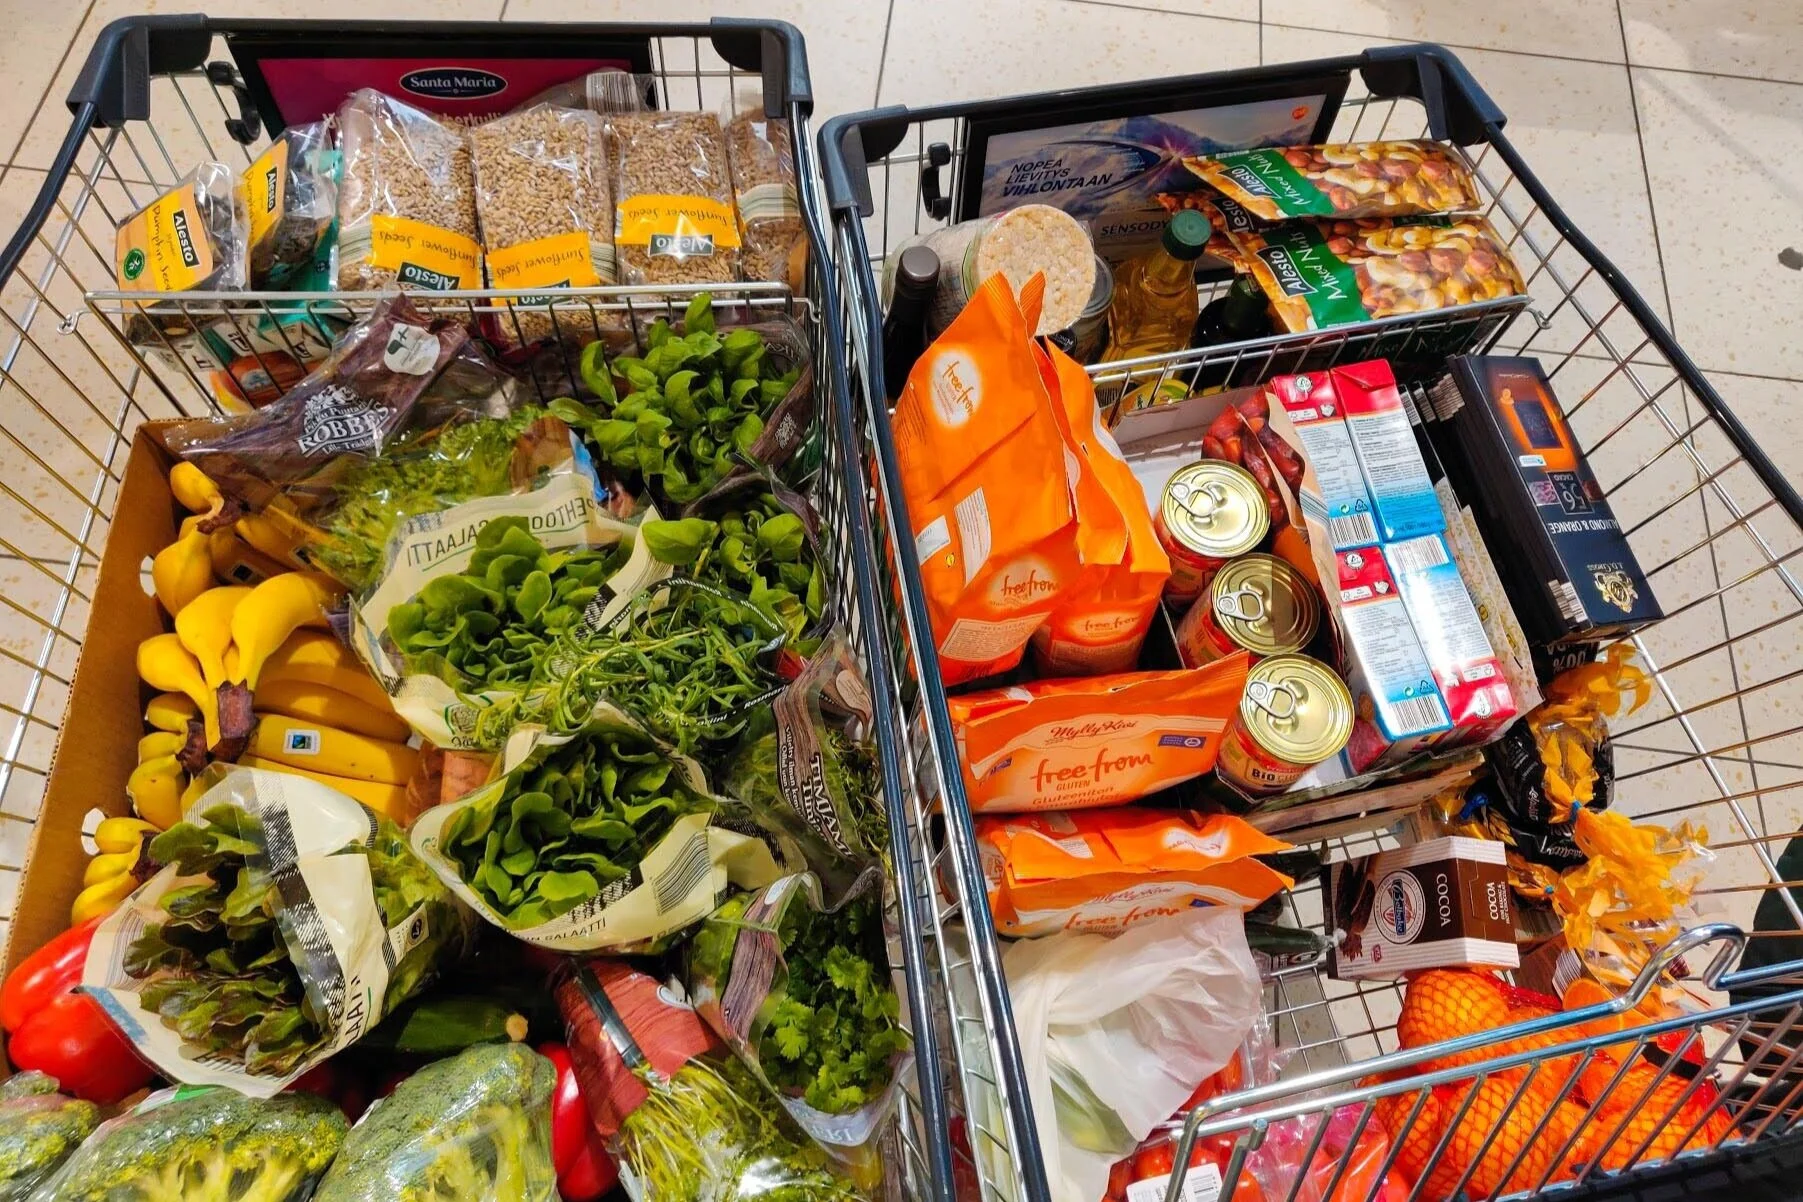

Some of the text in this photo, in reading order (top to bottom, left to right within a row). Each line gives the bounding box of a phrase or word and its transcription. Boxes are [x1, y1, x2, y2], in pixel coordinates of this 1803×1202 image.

[410, 76, 497, 89] Santa Maria
[1006, 168, 1071, 184] LIEVITYS
[1011, 158, 1063, 174] NOPEA
[266, 170, 277, 211] Alesto
[1003, 173, 1113, 197] VIHLONTAAN
[1231, 167, 1273, 196] Alesto
[1267, 174, 1312, 206] Mixed
[627, 206, 728, 226] Sunflower Seeds
[1102, 220, 1169, 235] SENSODY
[1222, 201, 1249, 233] lesto
[173, 214, 194, 263] Alesto
[378, 231, 478, 269] Sunflower Seeds
[656, 236, 712, 251] Alesto
[496, 249, 584, 278] Sunflower Seeds
[1269, 250, 1308, 291] Alesto
[404, 265, 456, 290] Alesto
[1304, 264, 1348, 300] Mixed
[297, 401, 390, 455] ROBBES
[1553, 474, 1574, 482] CACAO
[1549, 520, 1582, 534] ORANGE
[1001, 575, 1026, 598] free
[1083, 619, 1109, 632] free
[1031, 758, 1086, 792] free
[1086, 747, 1154, 781] from
[1056, 778, 1091, 792] GLUTEN
[1392, 884, 1405, 932] Belbake
[1436, 872, 1451, 928] COCOA
[1486, 881, 1499, 921] COCOA
[1065, 905, 1182, 930] free from
